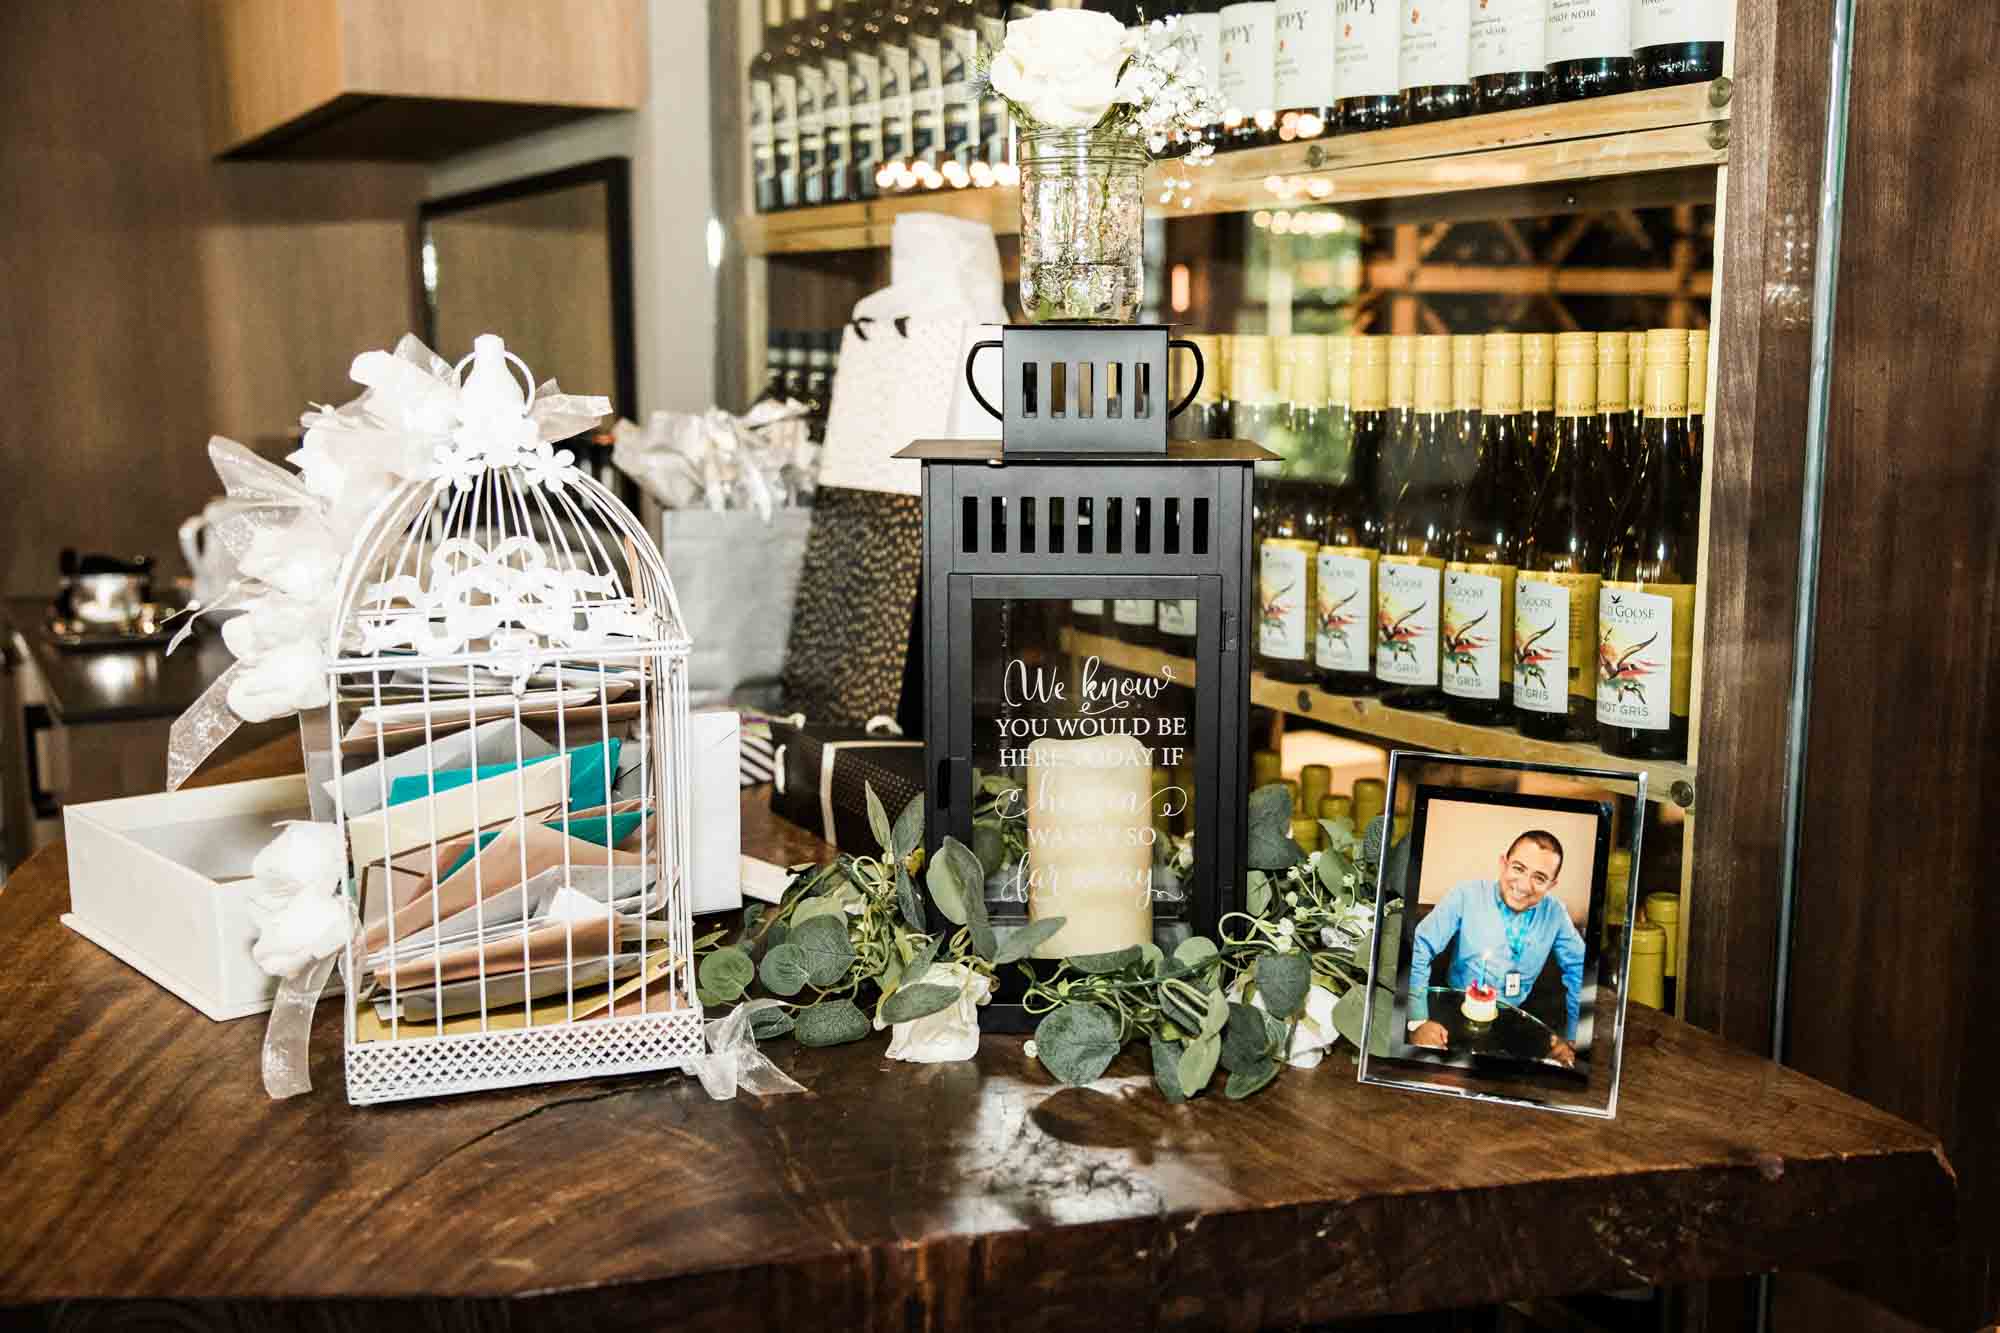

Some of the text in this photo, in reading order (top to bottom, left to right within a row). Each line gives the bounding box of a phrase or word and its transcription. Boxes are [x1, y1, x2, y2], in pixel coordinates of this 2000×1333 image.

[1615, 605, 1656, 619] GOOSE
[1004, 655, 1177, 714] We know
[1525, 688, 1550, 701] GRIS
[1620, 704, 1649, 717] GRIS
[996, 717, 1187, 737] YOU WOULD BE
[999, 748, 1060, 768] HERE
[1161, 748, 1184, 766] IF
[1127, 826, 1157, 846] SO
